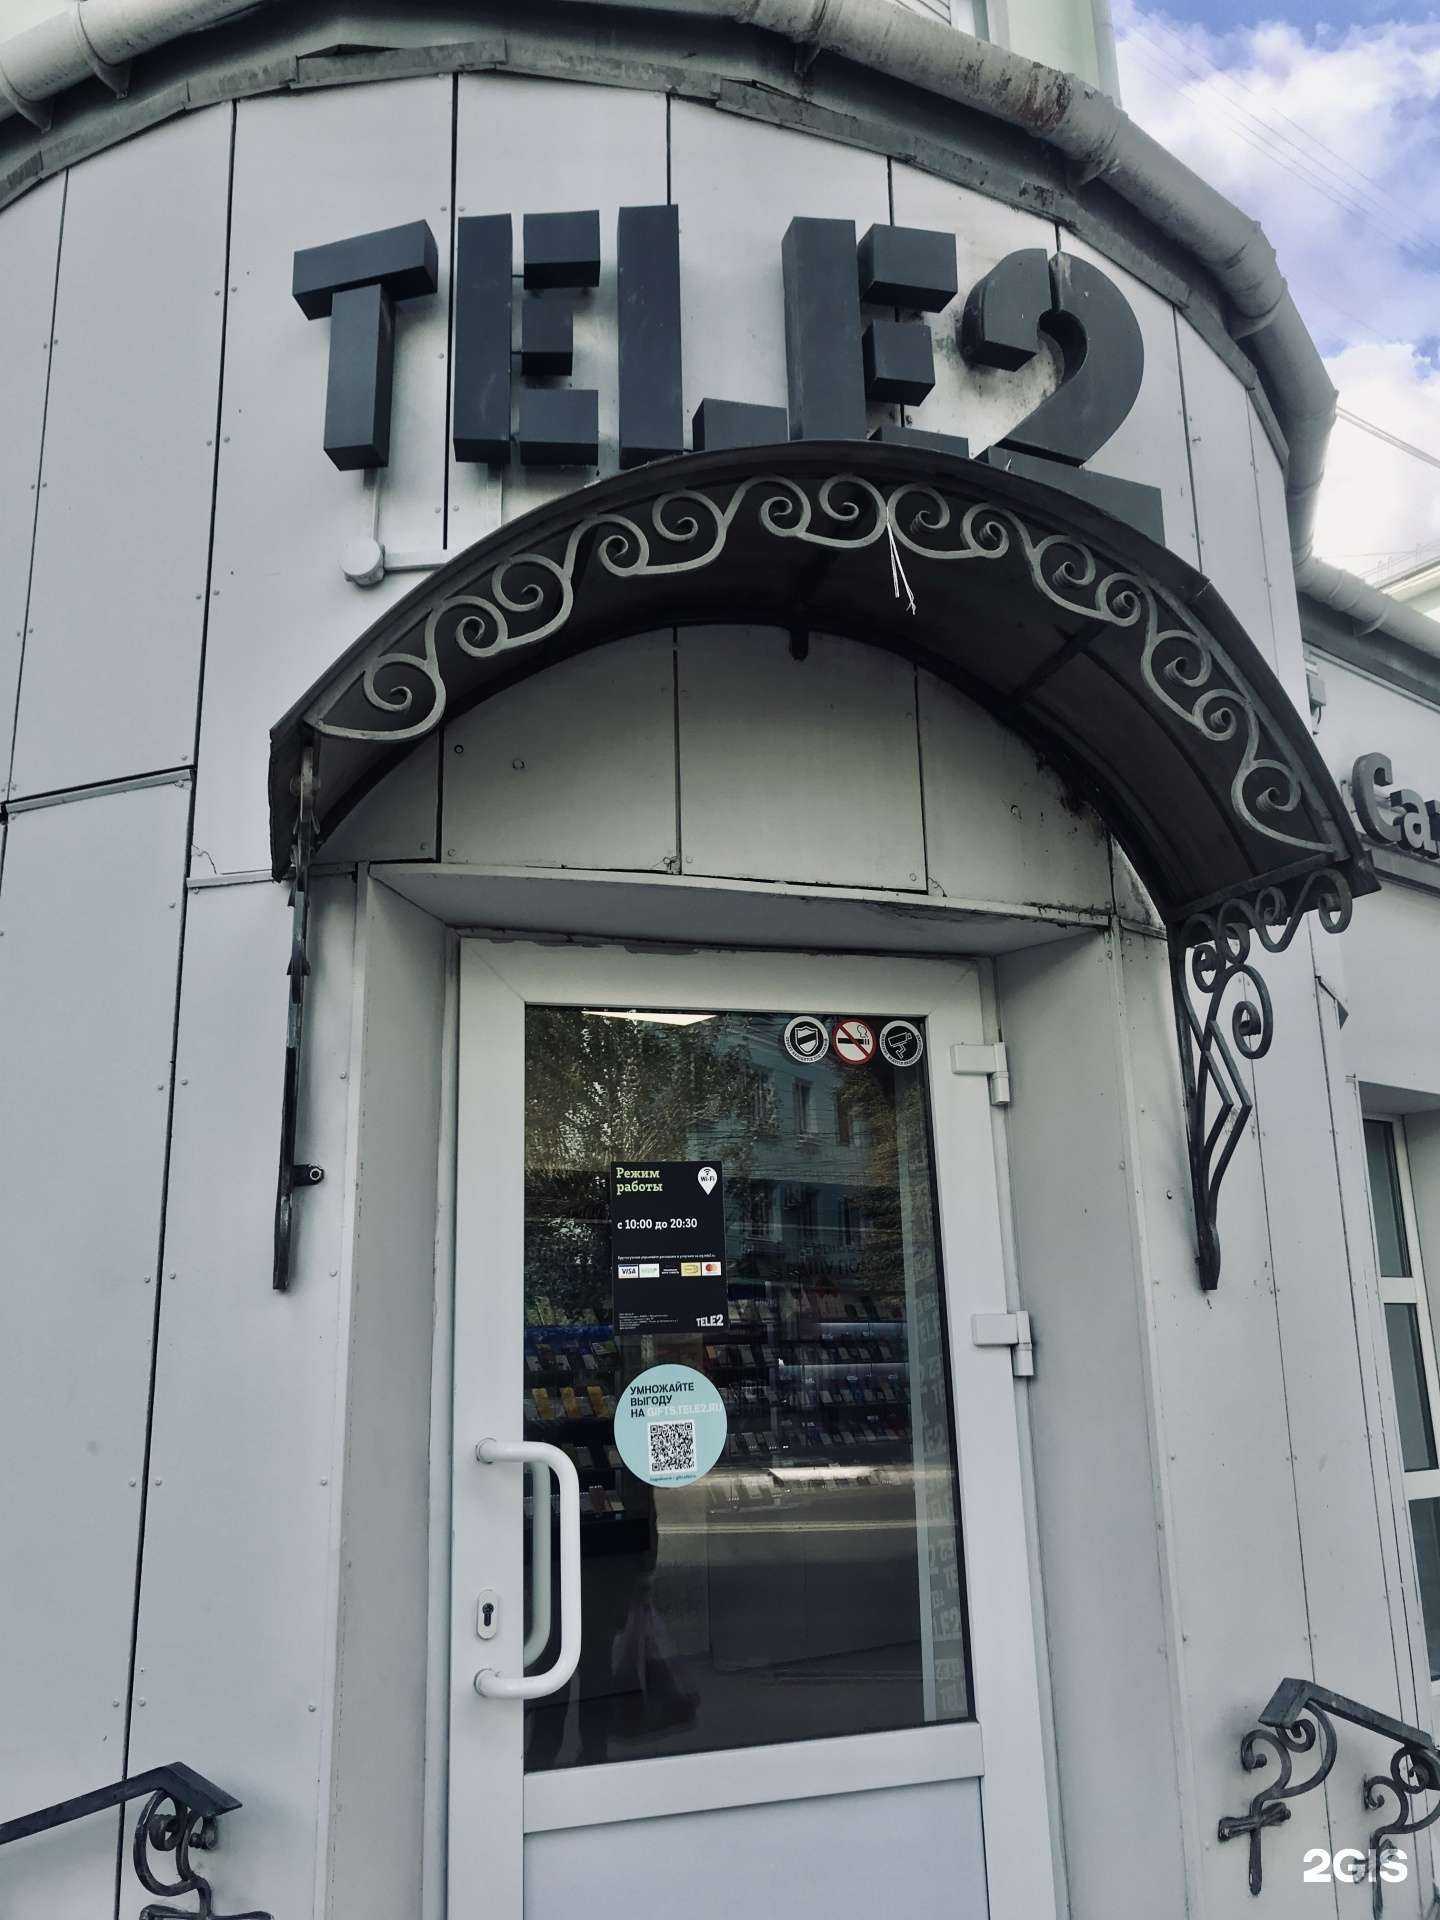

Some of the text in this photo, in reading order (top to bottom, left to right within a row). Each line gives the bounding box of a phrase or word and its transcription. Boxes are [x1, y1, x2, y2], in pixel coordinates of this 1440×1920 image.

[292, 204, 1163, 544] TELE2
[616, 1167, 660, 1179] Режим
[616, 1181, 663, 1195] работы
[617, 1218, 698, 1230] с 10:00 до 20:30
[696, 1314, 724, 1327] TELE2
[630, 1382, 695, 1395] УМНОЖАЙТЕ
[630, 1395, 673, 1407] ВЫГОДУ
[630, 1408, 645, 1418] НА
